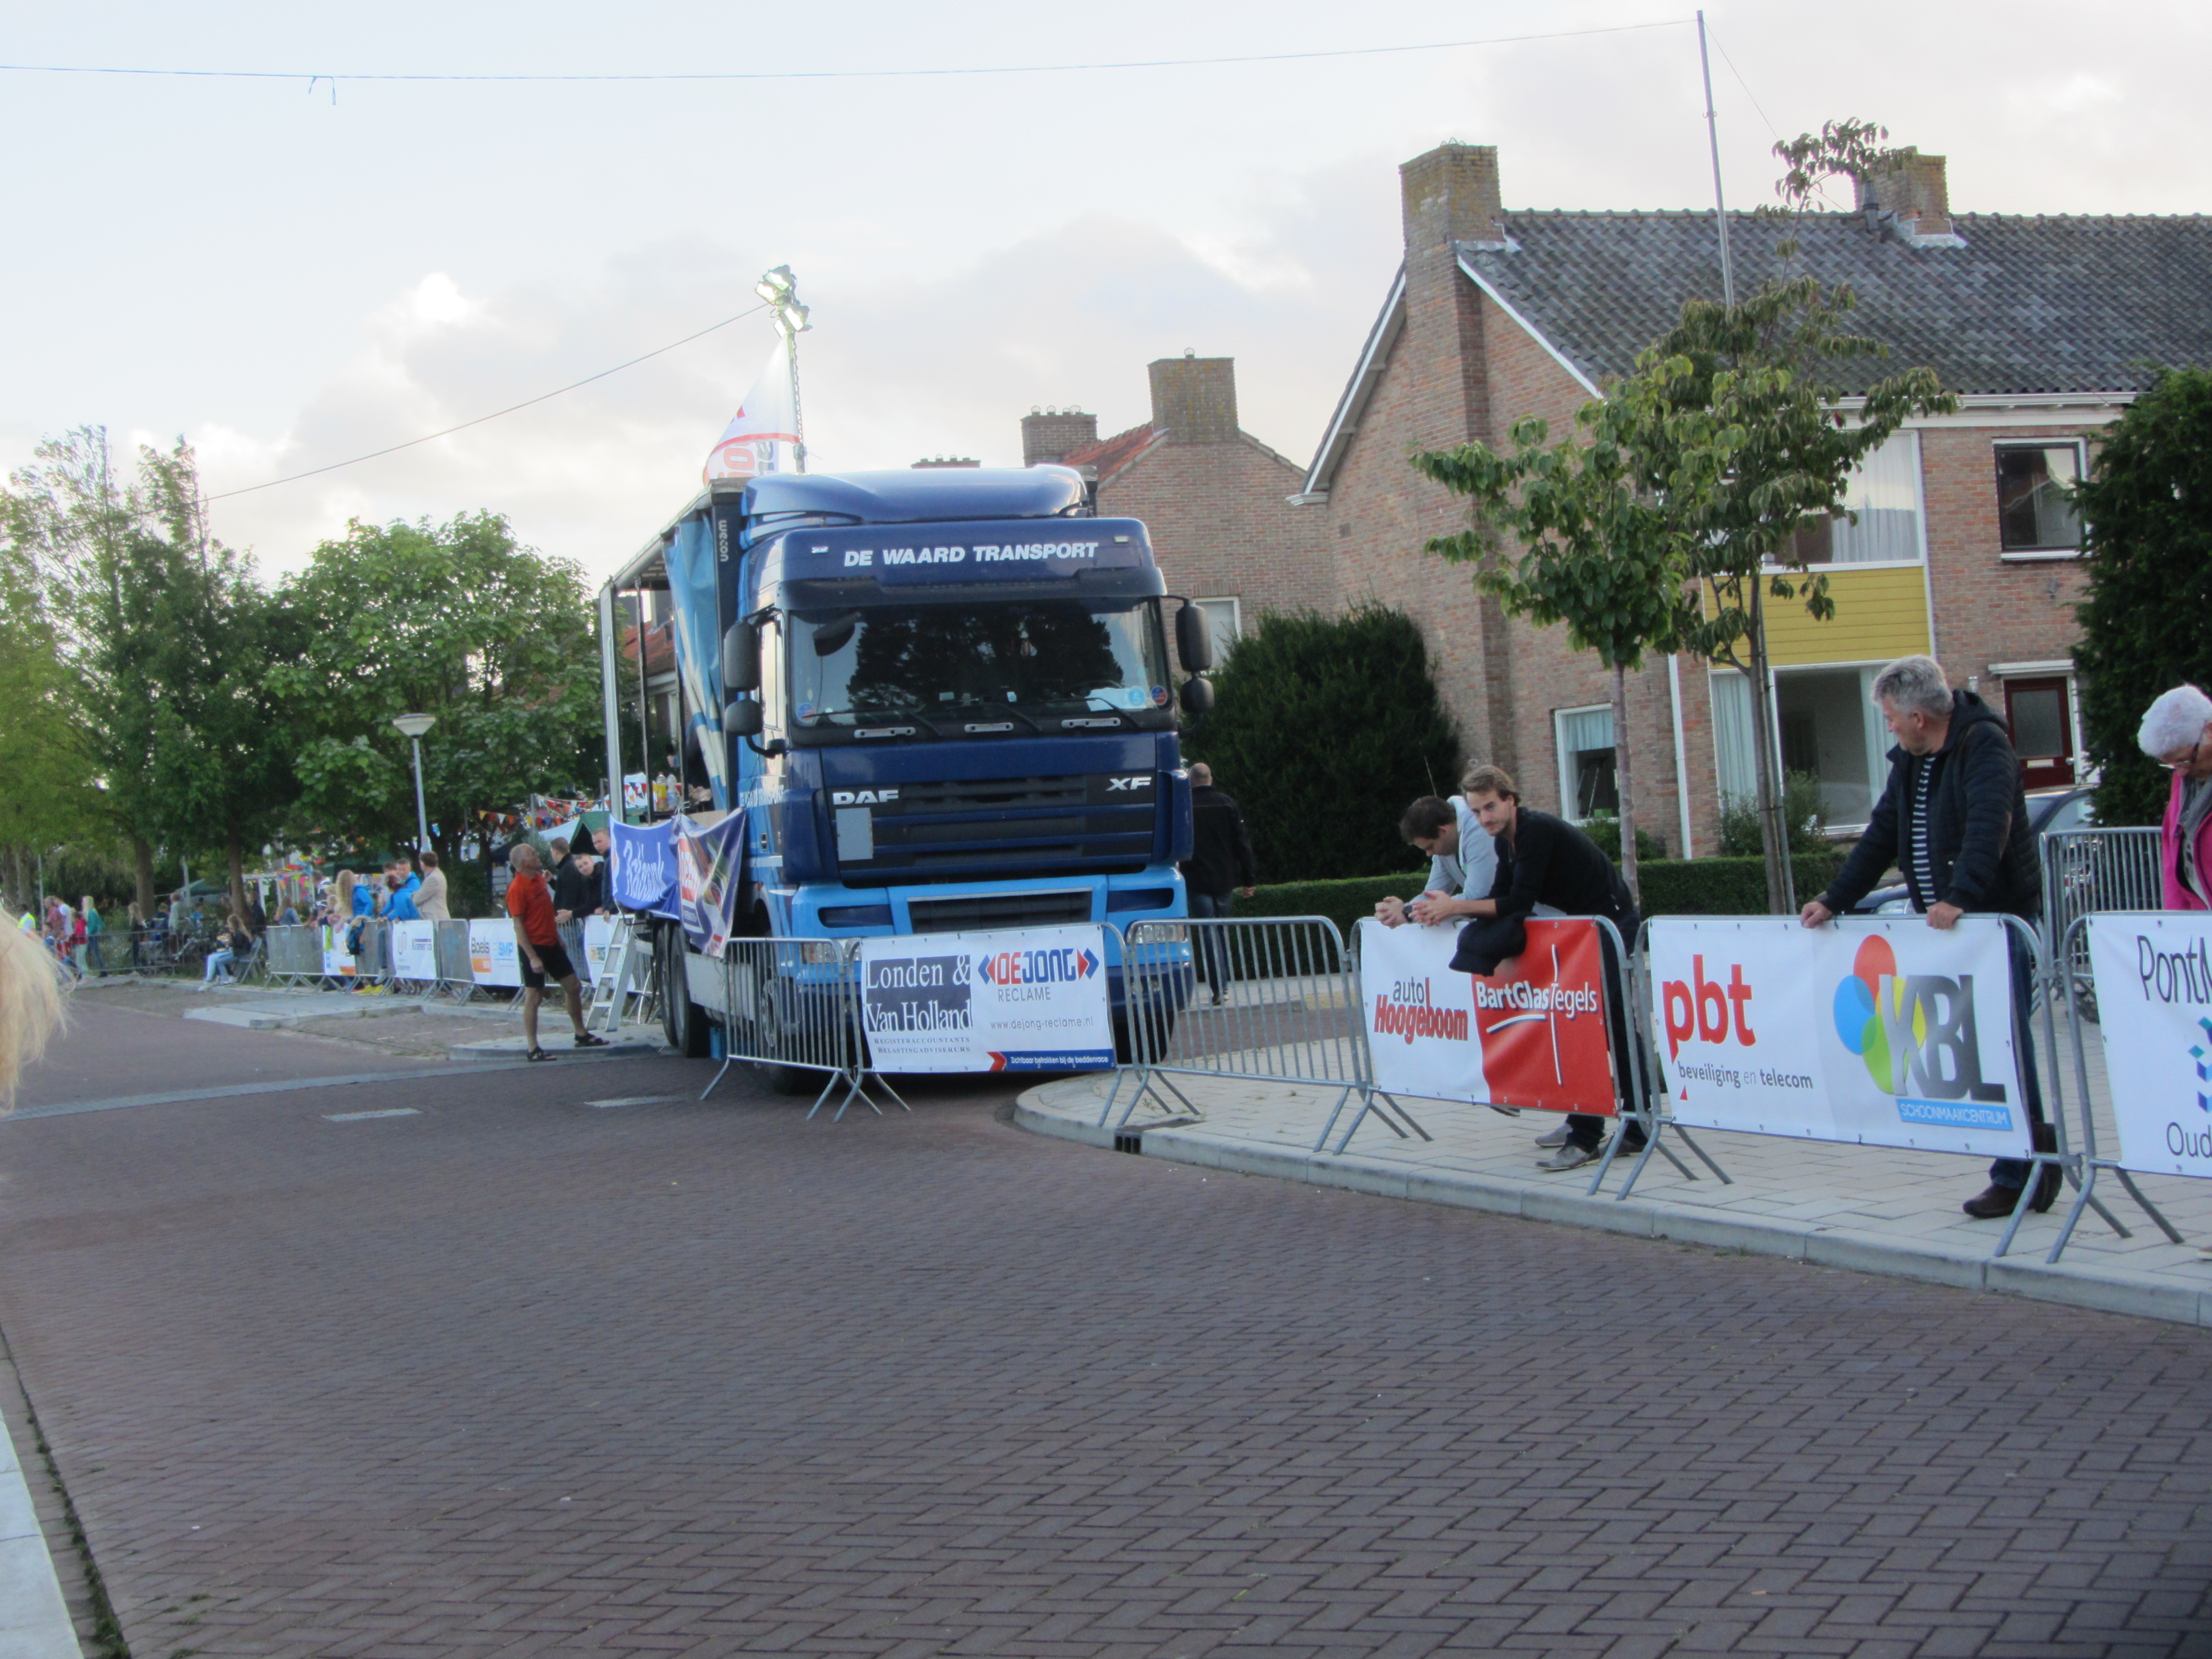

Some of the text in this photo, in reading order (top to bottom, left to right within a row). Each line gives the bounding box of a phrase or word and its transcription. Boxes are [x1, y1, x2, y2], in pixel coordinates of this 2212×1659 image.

[844, 542, 1098, 567] DE WAARD TRANSPORT
[1106, 776, 1151, 791] XF
[833, 790, 899, 805] DAF
[471, 937, 489, 954] Boels
[866, 955, 971, 989] Londen &
[998, 987, 1051, 1002] RECLAME
[1392, 977, 1425, 1001] auto
[866, 999, 972, 1032] Van Holland
[1374, 977, 1468, 1045] Hoogeboom
[1662, 954, 1756, 1064] pbt
[990, 1016, 1093, 1030] www.dejong-reclame.nl
[1678, 1061, 1814, 1089] beveiliging en telecom
[1900, 1102, 2008, 1126] SCHOONMAAKCENTRUM
[2166, 1121, 2212, 1159] Oud
